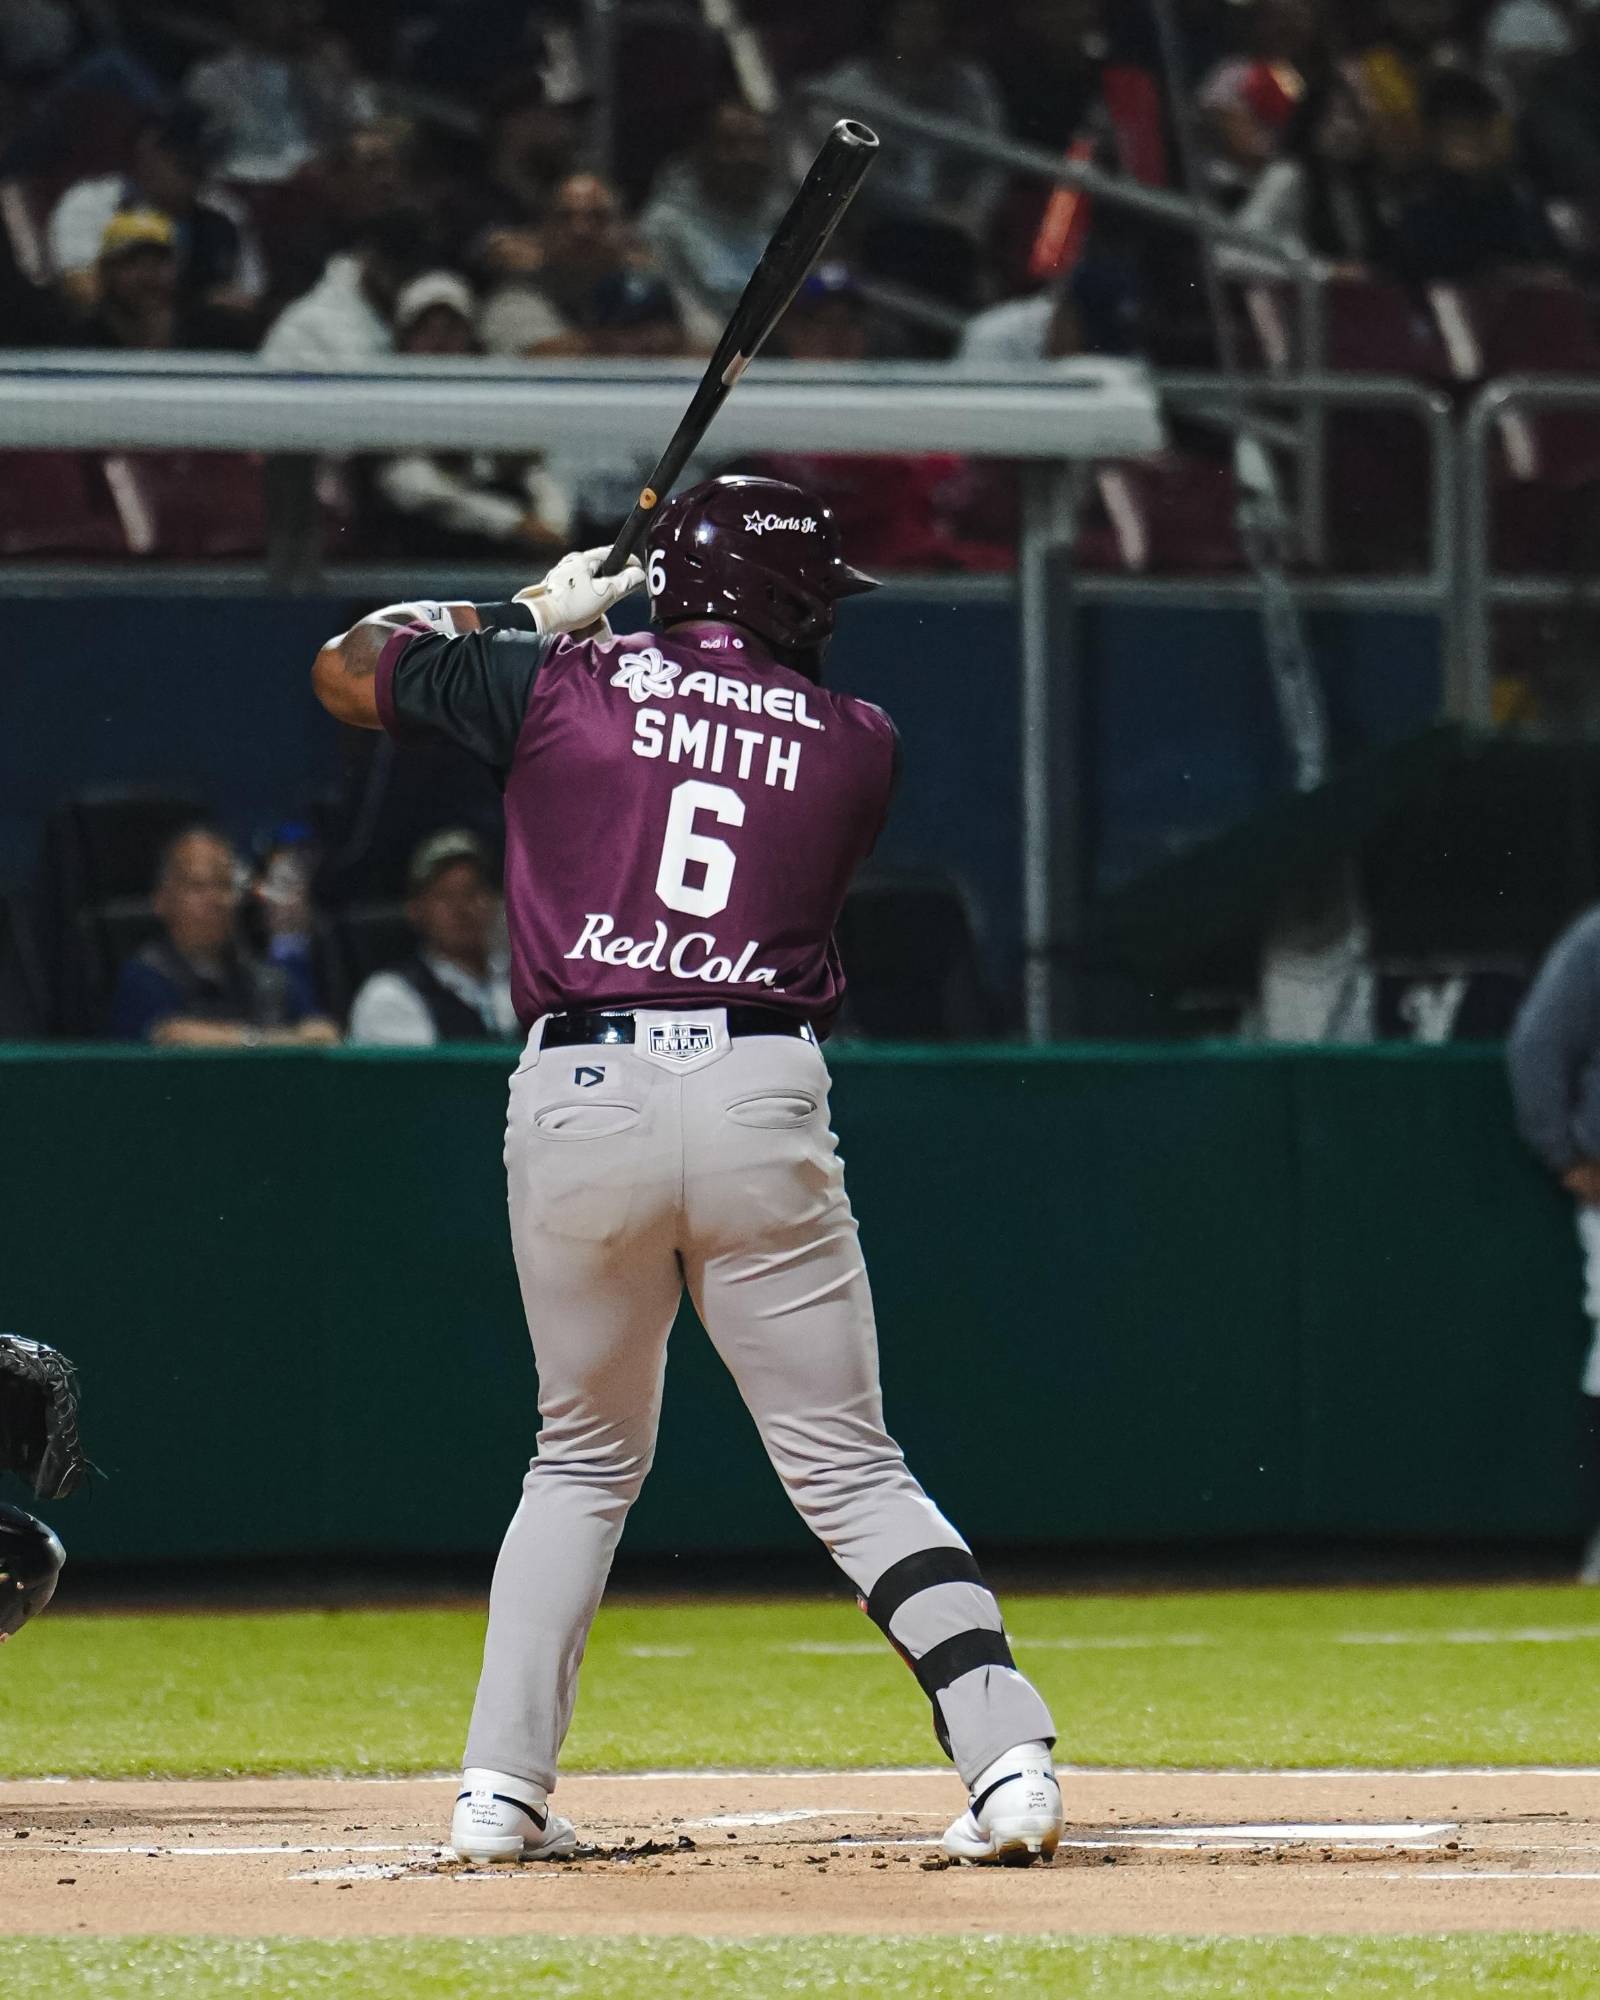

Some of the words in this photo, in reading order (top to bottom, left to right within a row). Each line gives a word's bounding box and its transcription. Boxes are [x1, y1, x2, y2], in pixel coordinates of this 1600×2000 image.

[648, 548, 667, 596] 6
[678, 671, 823, 730] ARIEL
[632, 707, 802, 791] SMITH
[655, 778, 746, 920] 6
